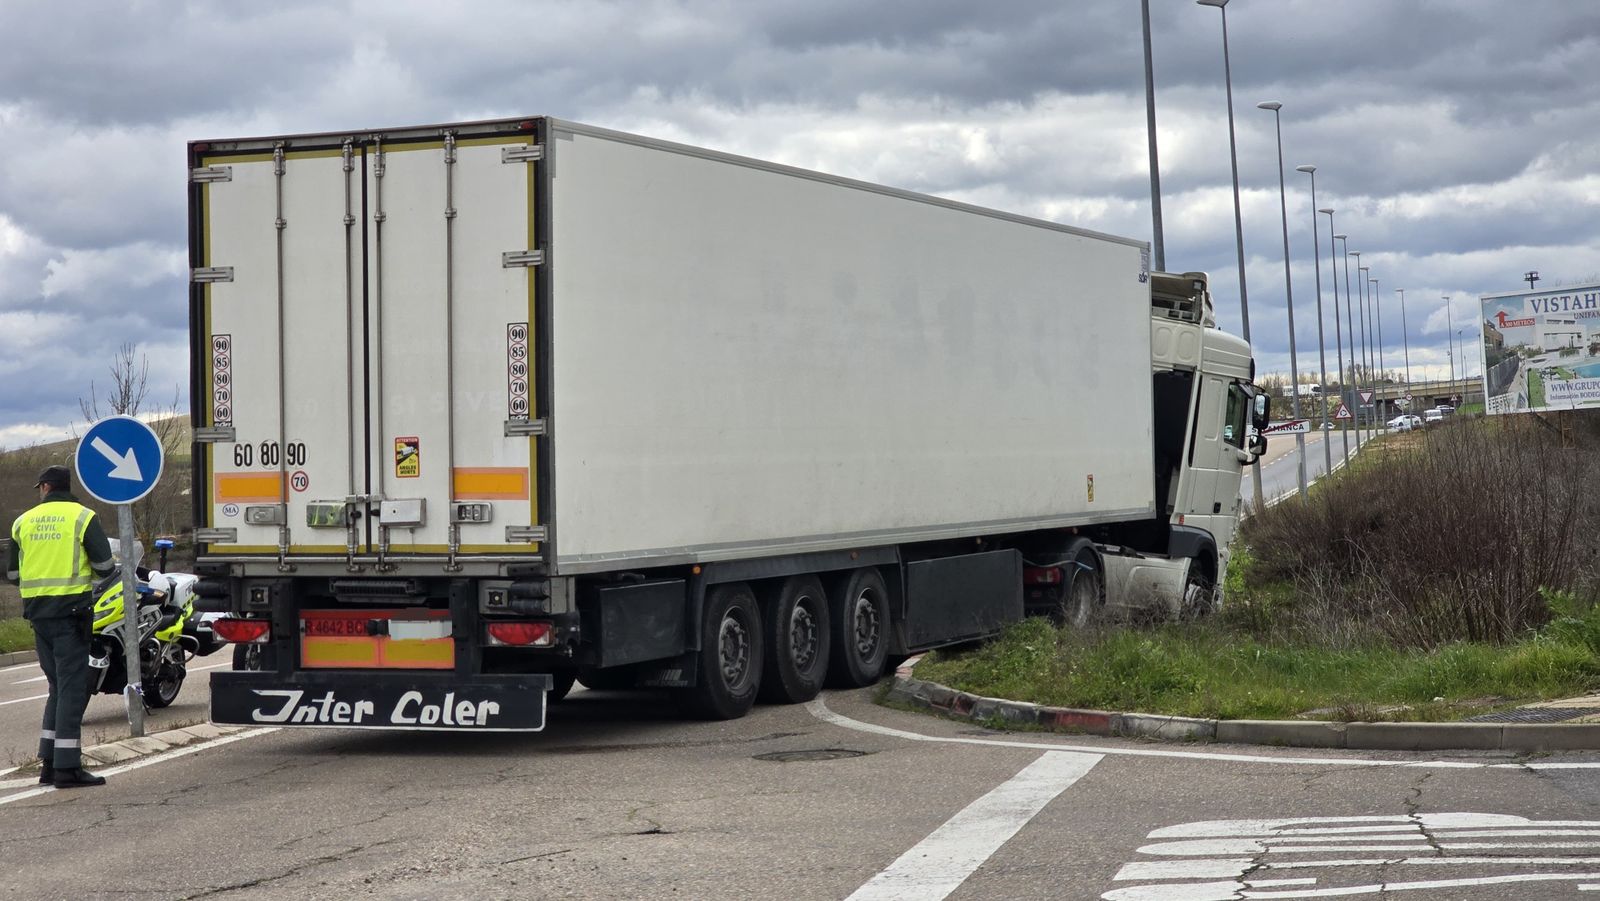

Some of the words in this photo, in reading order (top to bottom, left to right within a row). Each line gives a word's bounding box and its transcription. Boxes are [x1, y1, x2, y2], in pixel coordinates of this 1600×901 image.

[1531, 293, 1600, 314] VISTAH
[512, 328, 524, 340] 90
[216, 340, 227, 351] 90
[512, 346, 524, 358] 85
[216, 357, 227, 368] 85
[512, 364, 525, 375] 80
[216, 374, 228, 385] 80
[513, 382, 525, 393] 70
[216, 391, 228, 401] 70
[513, 399, 525, 411] 60
[216, 407, 229, 418] 60
[1251, 423, 1305, 434] SAMANCA
[234, 443, 253, 467] 60
[260, 442, 280, 466] 80
[287, 442, 306, 466] 90
[294, 476, 306, 487] 70
[37, 524, 56, 532] CIVIL
[30, 533, 61, 541] TRAFICO
[390, 690, 501, 726] Coler
